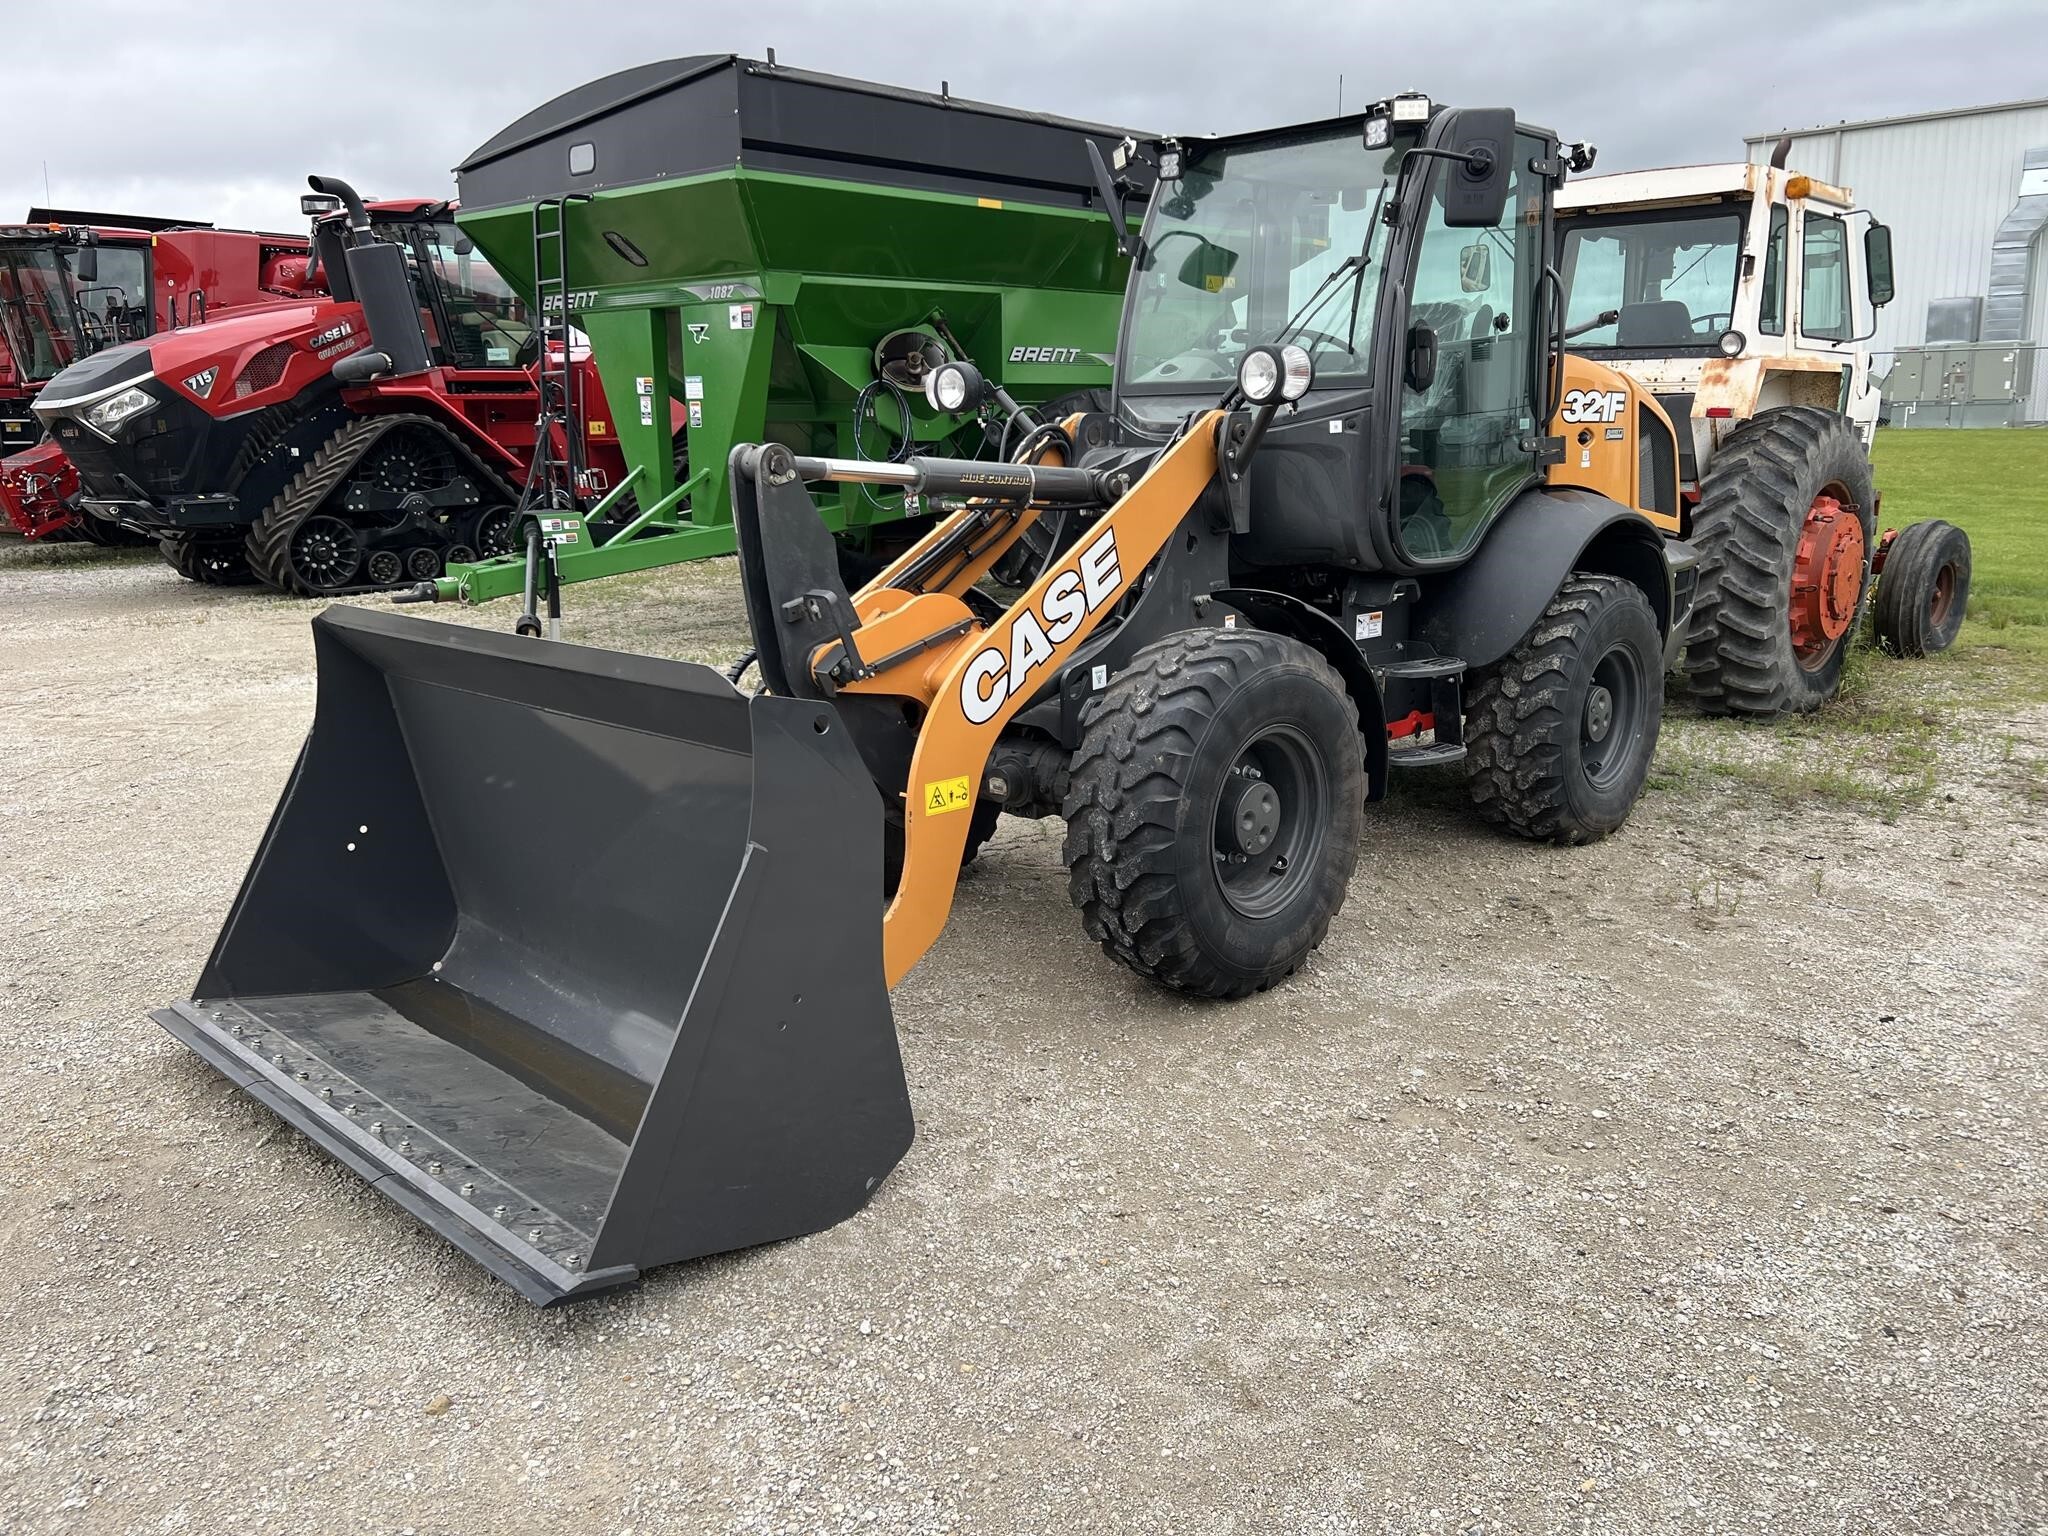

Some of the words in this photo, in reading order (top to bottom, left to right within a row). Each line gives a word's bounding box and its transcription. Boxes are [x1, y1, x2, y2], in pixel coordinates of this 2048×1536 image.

[543, 291, 598, 310] BRENT
[710, 284, 735, 299] 1082
[309, 327, 341, 349] CASE
[1008, 346, 1081, 363] BRENT
[188, 370, 212, 390] 715
[1561, 389, 1626, 424] 321F
[960, 472, 985, 484] RIDE
[985, 473, 1031, 486] CONTROL
[960, 525, 1123, 725] CASE
